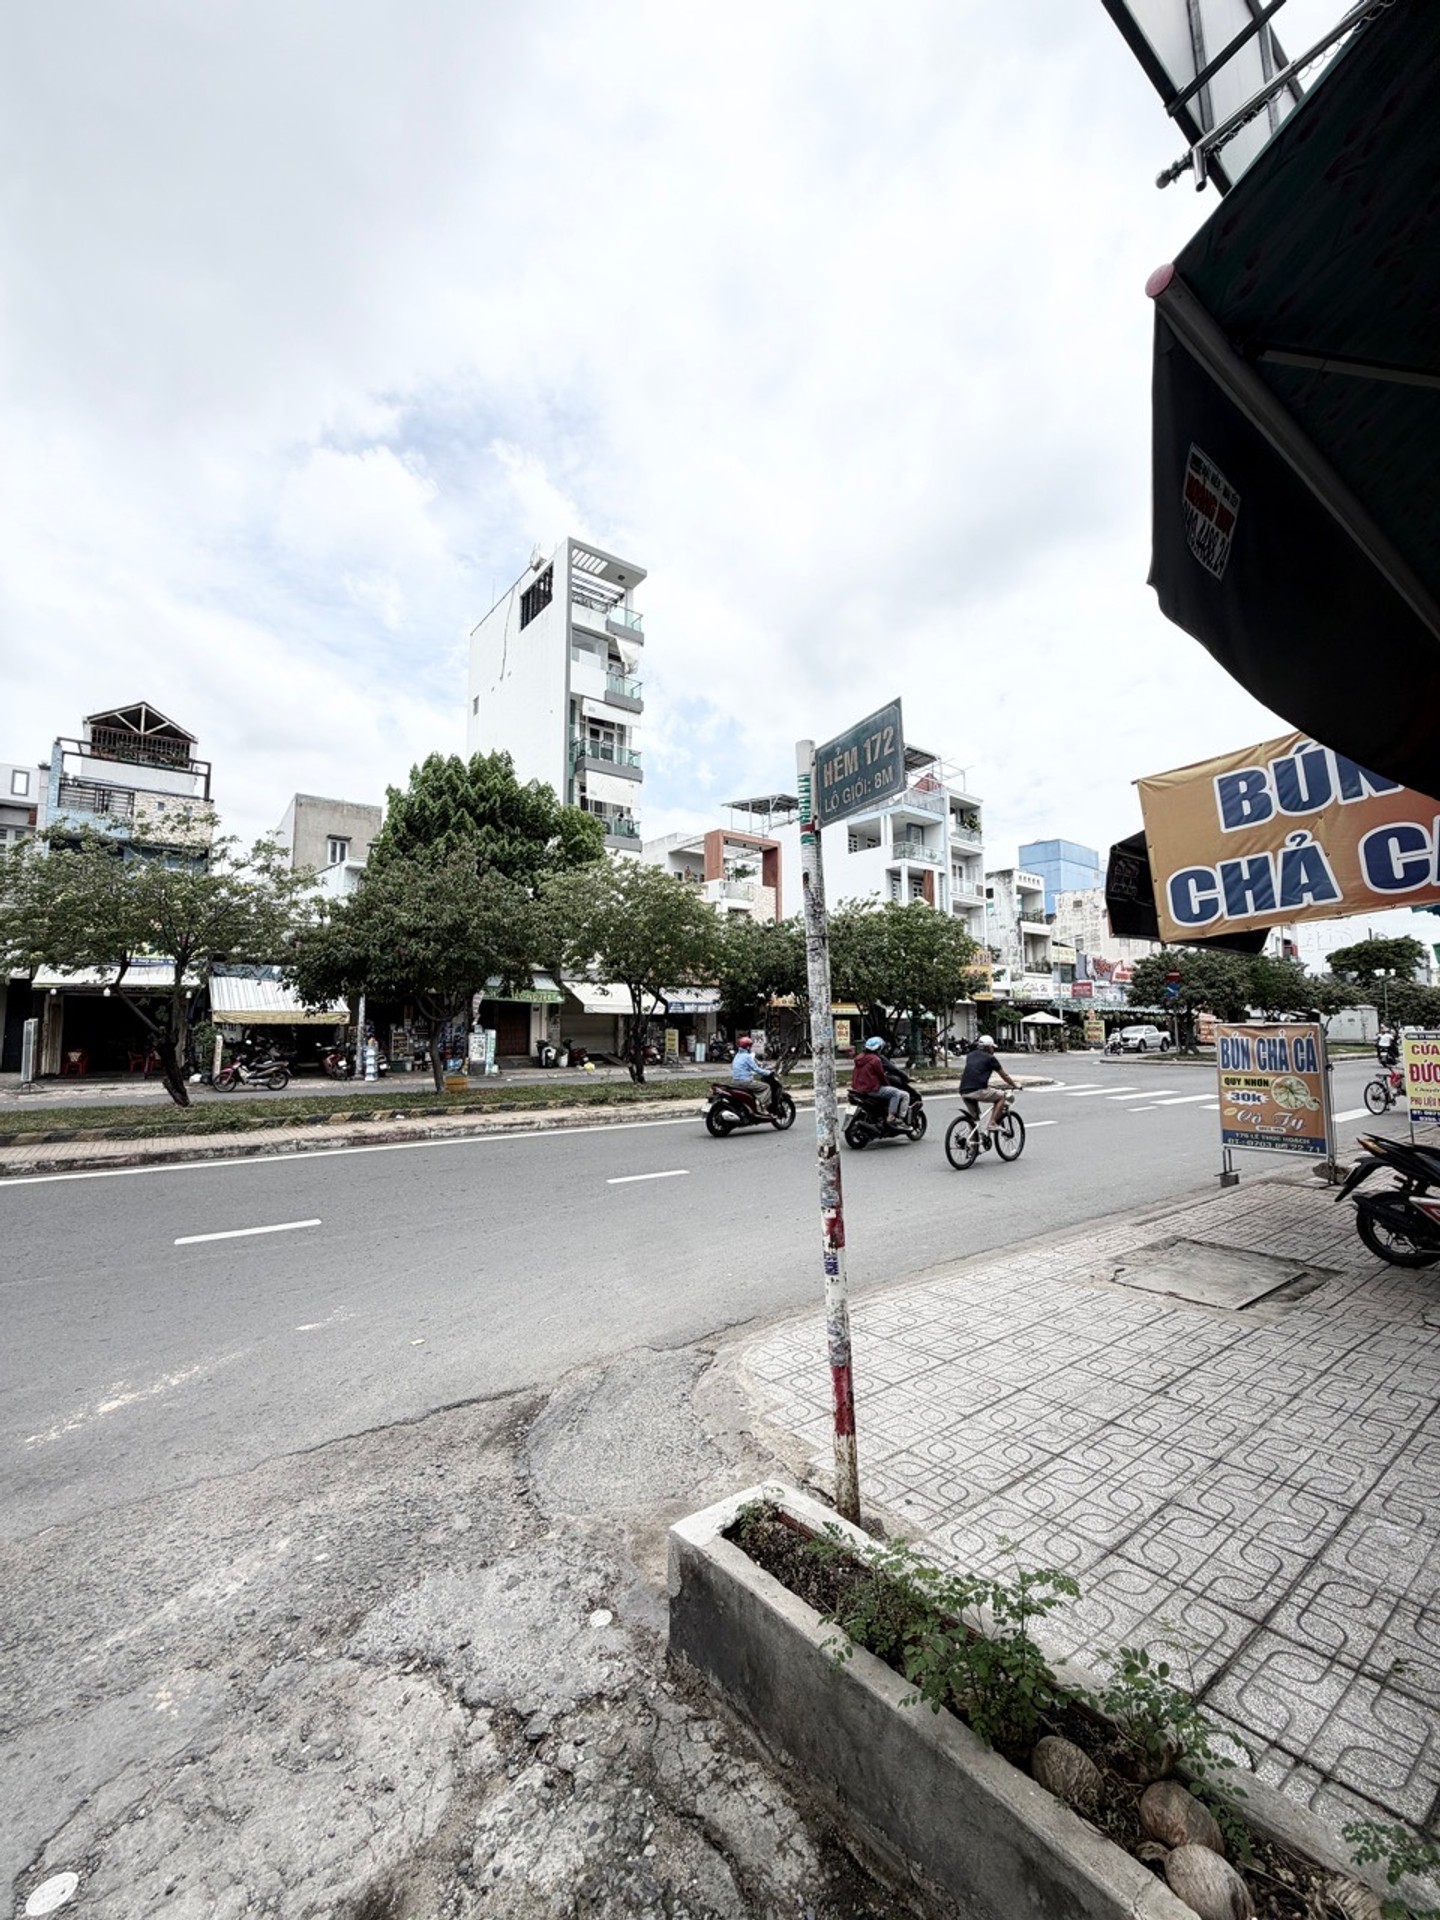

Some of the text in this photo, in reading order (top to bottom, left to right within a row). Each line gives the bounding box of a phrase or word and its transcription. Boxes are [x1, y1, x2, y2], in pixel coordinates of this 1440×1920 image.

[823, 726, 894, 788] HẺM 172
[824, 791, 841, 815] LỘ
[874, 765, 894, 789] 8M
[1166, 830, 1343, 927] CHẢ
[1358, 815, 1440, 894] C
[1219, 1029, 1319, 1074] BÚN CHẢ CÁ
[1224, 1077, 1242, 1086] QUY
[1231, 1092, 1263, 1102] 30k
